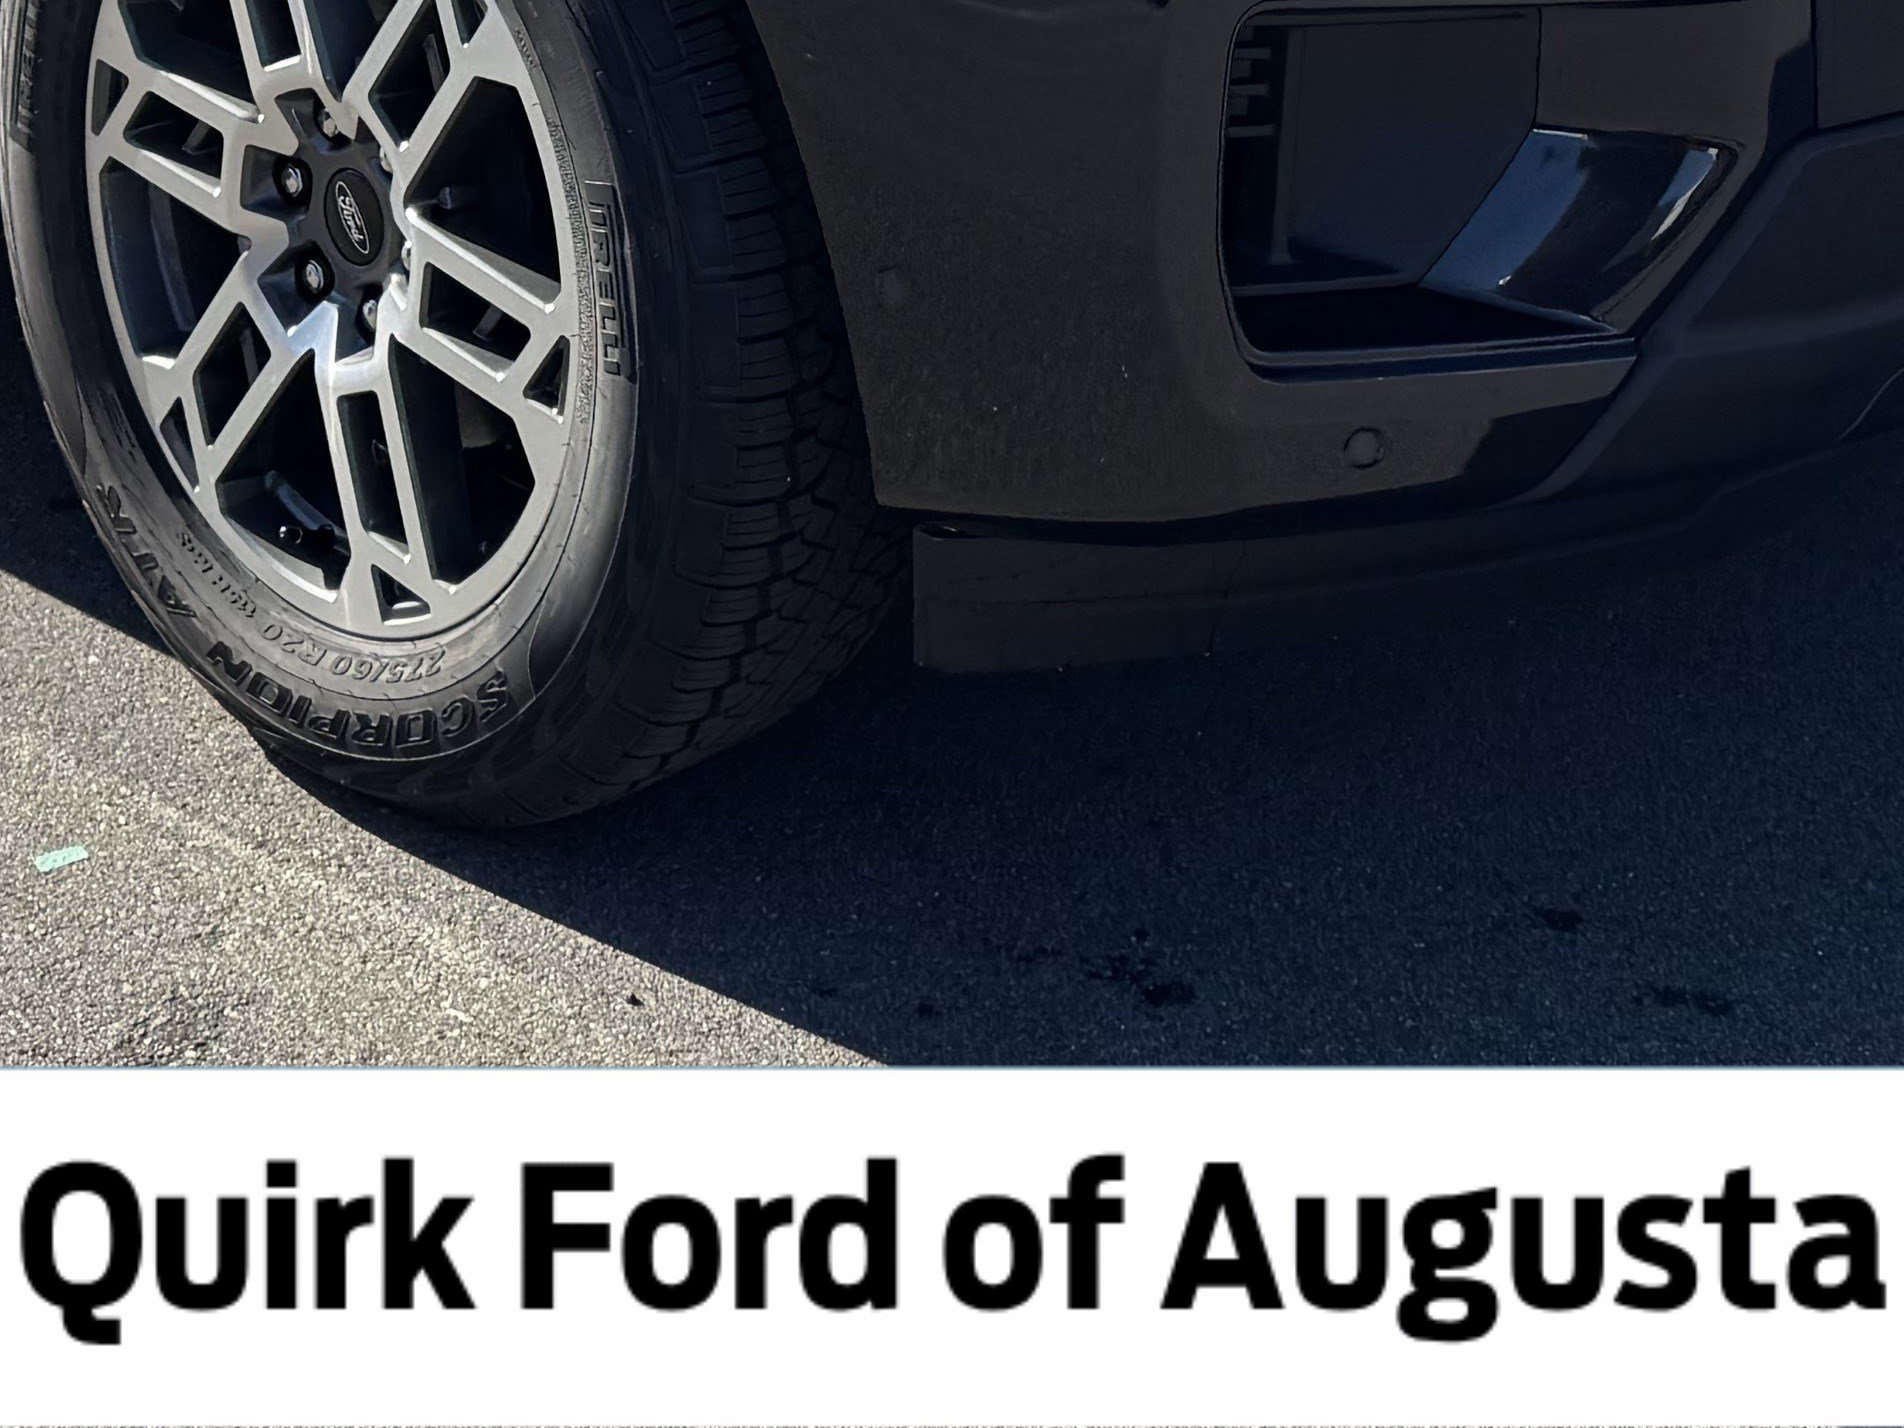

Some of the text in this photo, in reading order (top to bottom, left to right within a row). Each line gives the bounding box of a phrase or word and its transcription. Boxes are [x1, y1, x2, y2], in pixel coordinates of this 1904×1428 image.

[258, 621, 326, 676] R20
[331, 646, 447, 685] 275/60
[205, 641, 513, 752] SCORPION
